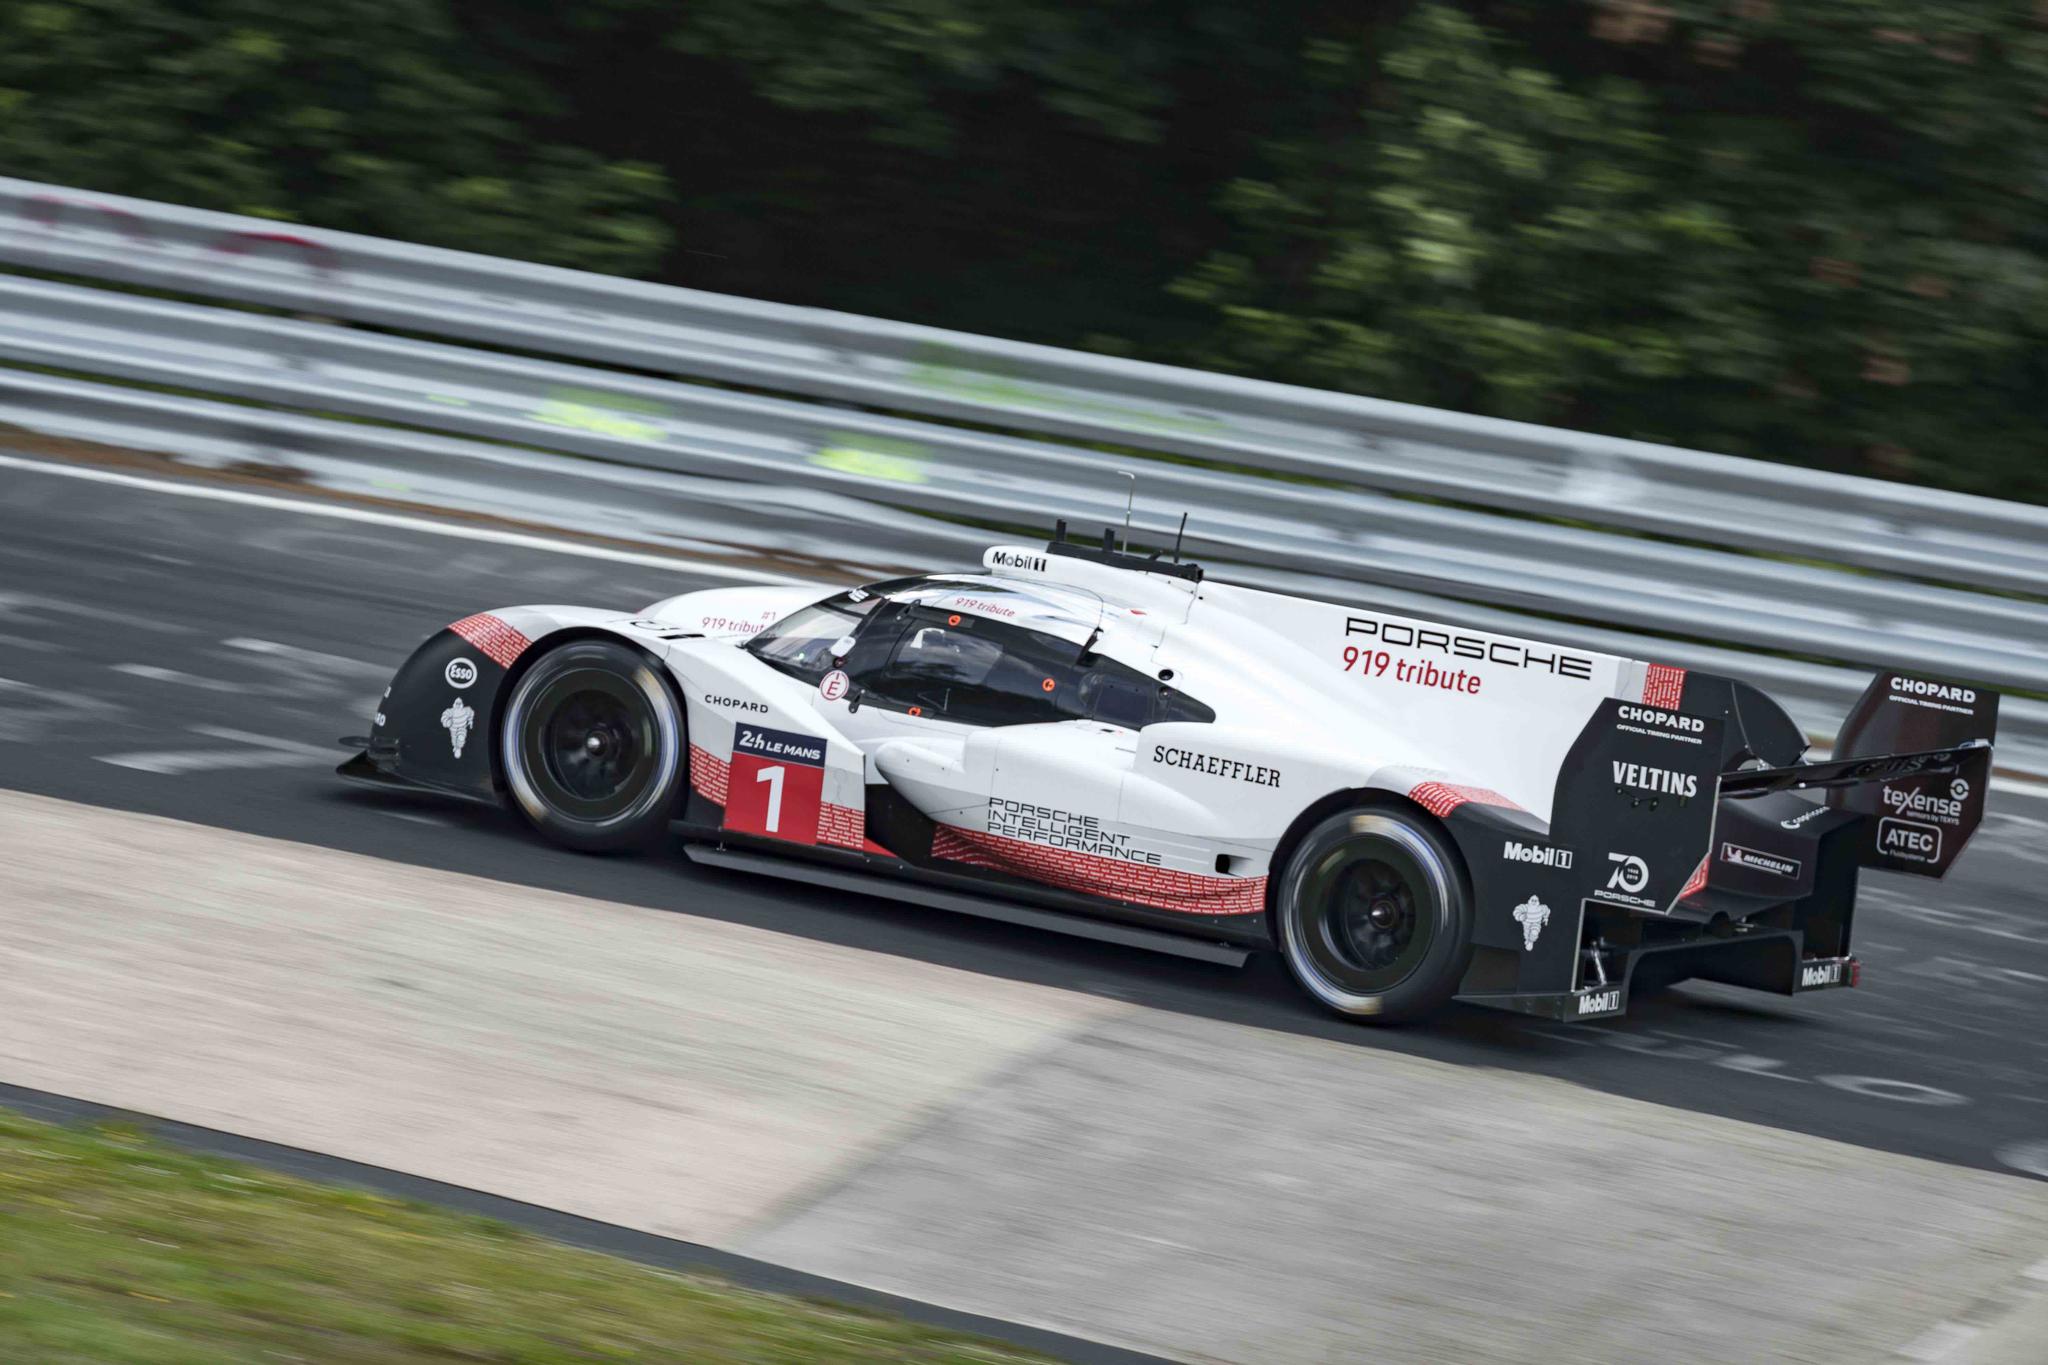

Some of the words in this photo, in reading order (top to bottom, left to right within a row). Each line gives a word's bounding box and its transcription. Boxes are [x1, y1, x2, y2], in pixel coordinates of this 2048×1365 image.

[993, 551, 1032, 569] Mobil
[955, 597, 976, 609] 919
[977, 601, 1015, 618] tribute
[702, 616, 726, 630] 919
[1345, 617, 1592, 681] PORSCHE
[1343, 646, 1390, 677] 919
[1396, 660, 1481, 695] tribute
[827, 681, 840, 696] E
[1890, 677, 1976, 703] CHOPARD
[704, 694, 769, 714] CHOPARD
[1618, 705, 1704, 733] CHOPARD
[1616, 724, 1647, 735] OFFICIAL
[1670, 733, 1702, 745] PARTNER
[766, 741, 783, 753] LE
[783, 743, 821, 760] MANS
[1153, 745, 1281, 788] SCHAEFFLER
[1612, 760, 1697, 798] VELTINS
[756, 765, 785, 833] 1
[989, 797, 1099, 828] PORSCHE
[988, 809, 1130, 846] INTELLIGENT
[987, 822, 1162, 866] PERFORMANCE
[1885, 828, 1933, 852] ATEC
[1503, 841, 1555, 866] Mobil
[1743, 854, 1794, 873] MICHELIN
[1606, 852, 1649, 893] 70
[1593, 889, 1656, 908] PORSCHE
[1801, 965, 1831, 987] Mobil
[1578, 992, 1609, 1014] Mobil
